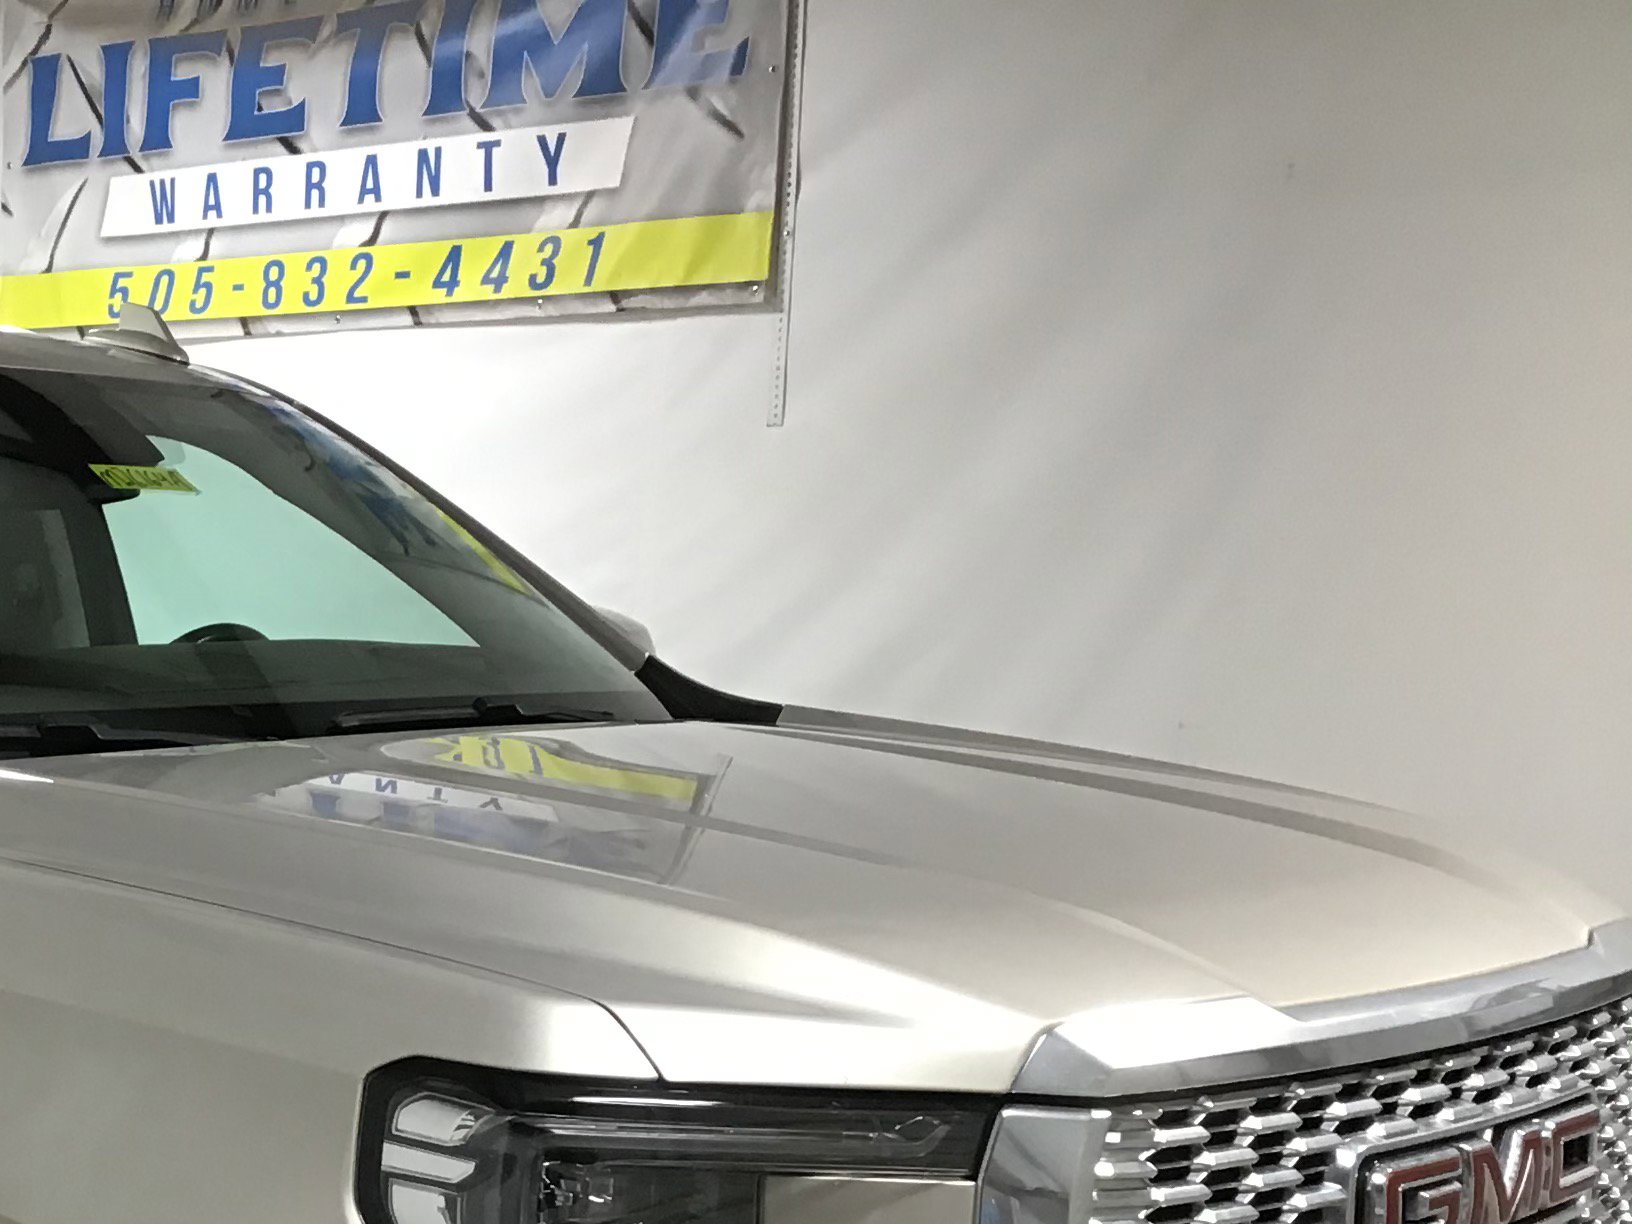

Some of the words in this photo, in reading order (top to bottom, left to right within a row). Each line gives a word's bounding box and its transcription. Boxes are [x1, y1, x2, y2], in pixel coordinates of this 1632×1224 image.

[20, 0, 750, 168] LIFETIME
[149, 131, 569, 227] WARRANTY
[106, 231, 608, 319] 505-832-4431
